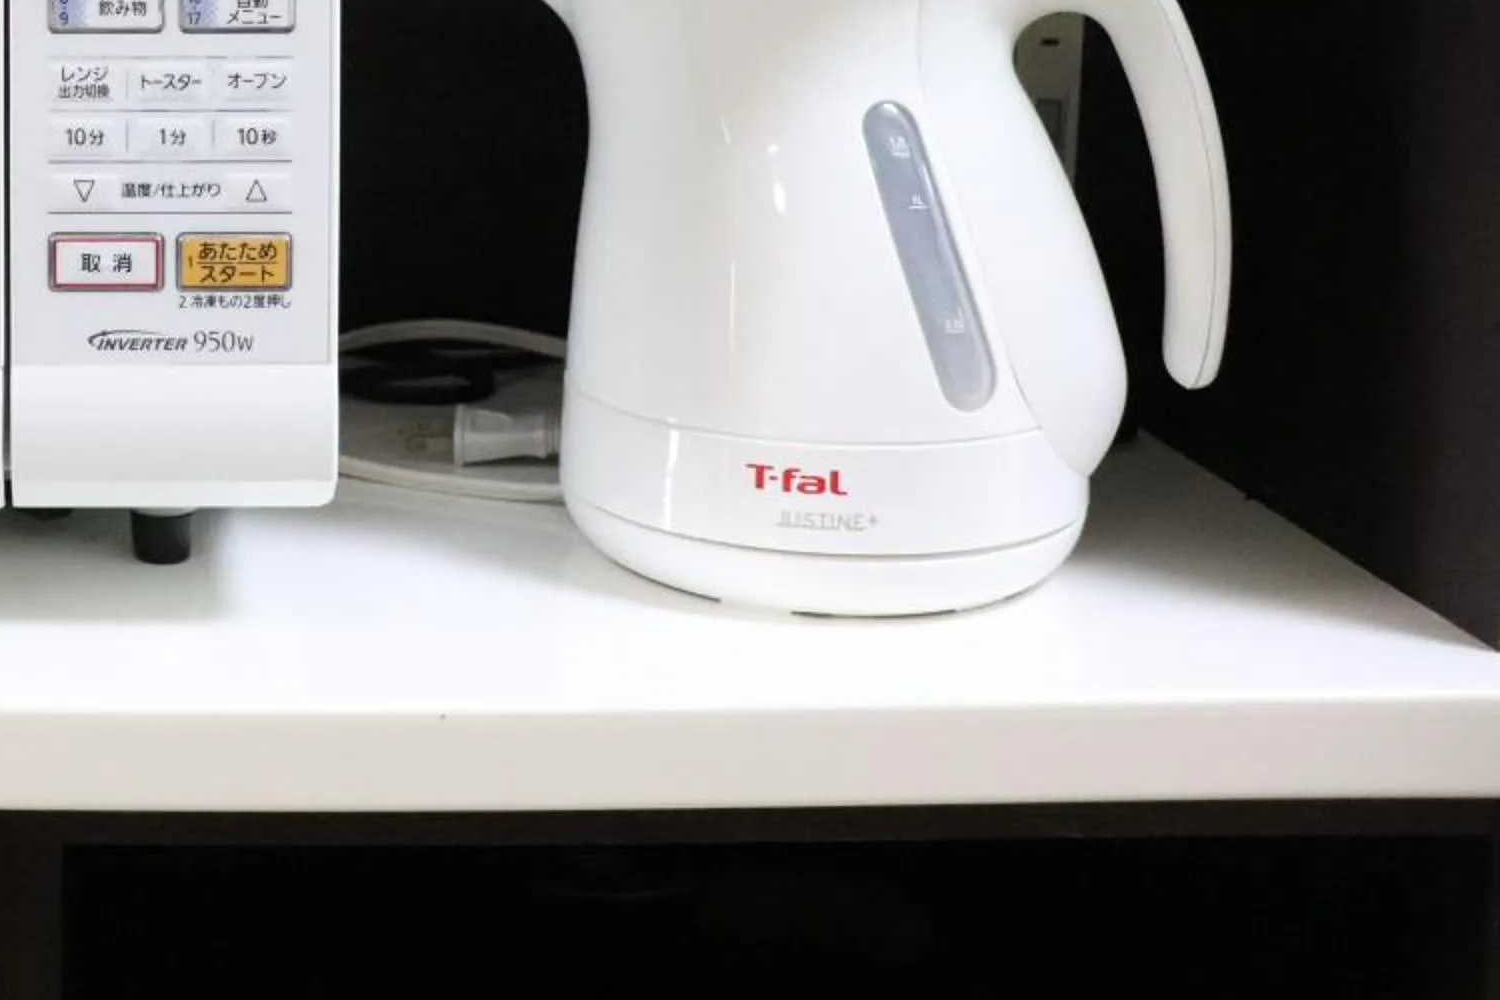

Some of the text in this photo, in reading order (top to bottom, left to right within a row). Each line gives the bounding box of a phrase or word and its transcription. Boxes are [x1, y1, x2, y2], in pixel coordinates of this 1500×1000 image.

[99, 0, 147, 17] 飲み物
[227, 10, 283, 24] メニュー
[59, 12, 69, 25] 9
[188, 12, 200, 24] 17
[61, 66, 109, 82] レンジ
[140, 73, 202, 90] トースター
[227, 72, 287, 89] オープン
[65, 128, 105, 146] 10分
[159, 128, 187, 146] 1分
[237, 127, 277, 146] 10秒
[121, 182, 221, 199] 温度/仕上がり
[199, 241, 278, 261] あたため
[199, 266, 275, 284] スタート
[87, 329, 188, 351] INVERTER
[745, 463, 849, 496] T-fal
